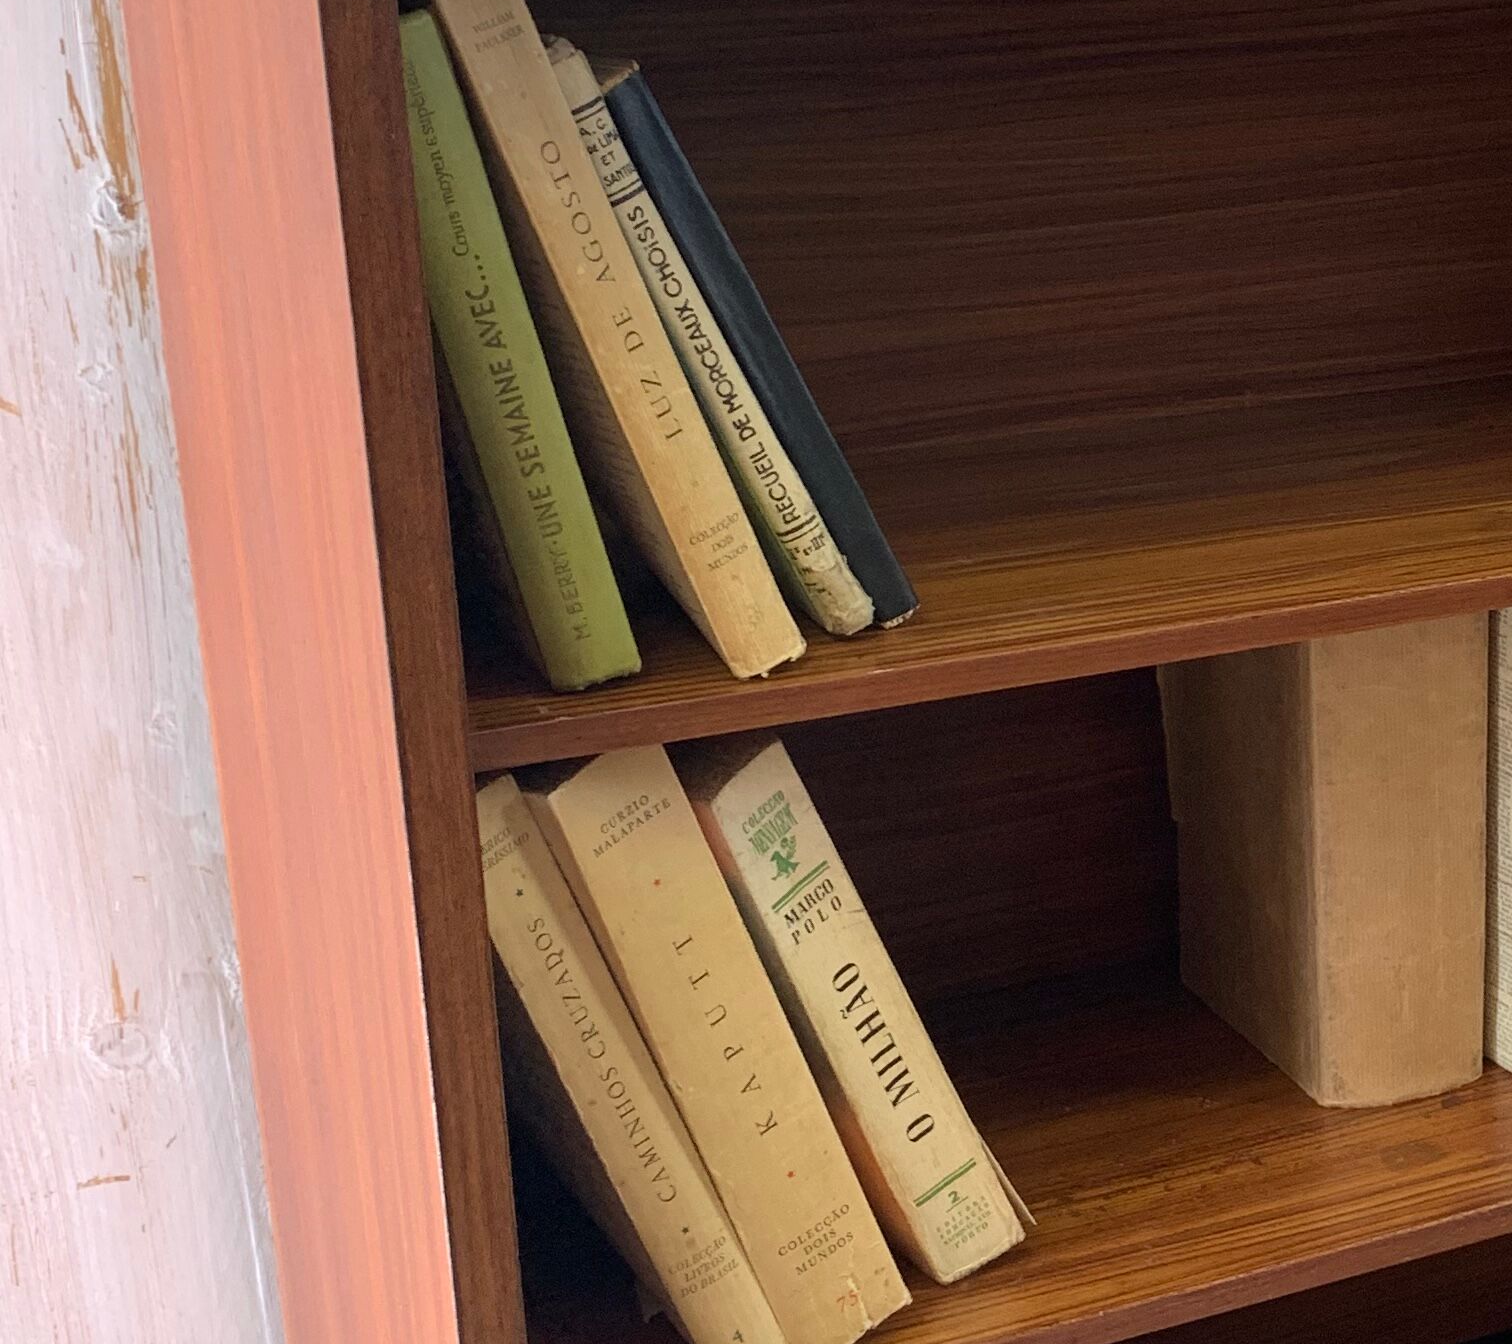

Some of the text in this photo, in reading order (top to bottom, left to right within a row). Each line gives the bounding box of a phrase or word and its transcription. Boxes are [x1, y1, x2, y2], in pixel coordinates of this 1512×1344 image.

[430, 149, 455, 206] moyen
[449, 211, 469, 257] Cours
[540, 140, 683, 440] LUZ DE AGOSTO
[675, 297, 744, 414] MORCEAUX
[489, 358, 545, 479] SEMAINE
[732, 413, 757, 442] DE
[748, 441, 800, 525] RECUEIL
[528, 485, 563, 539] UNE
[592, 798, 671, 858] MALAPARTE
[600, 794, 649, 834] CURZIO
[784, 878, 834, 929] MARCO
[791, 895, 842, 945] POLO
[527, 918, 677, 1203] CAMINHOS CRUZADOS
[671, 934, 778, 1136] KAPUTT
[831, 962, 935, 1143] O MILHÃO
[948, 1191, 960, 1204] 2
[795, 1232, 854, 1275] MUNDOS
[803, 1228, 836, 1255] DOIS
